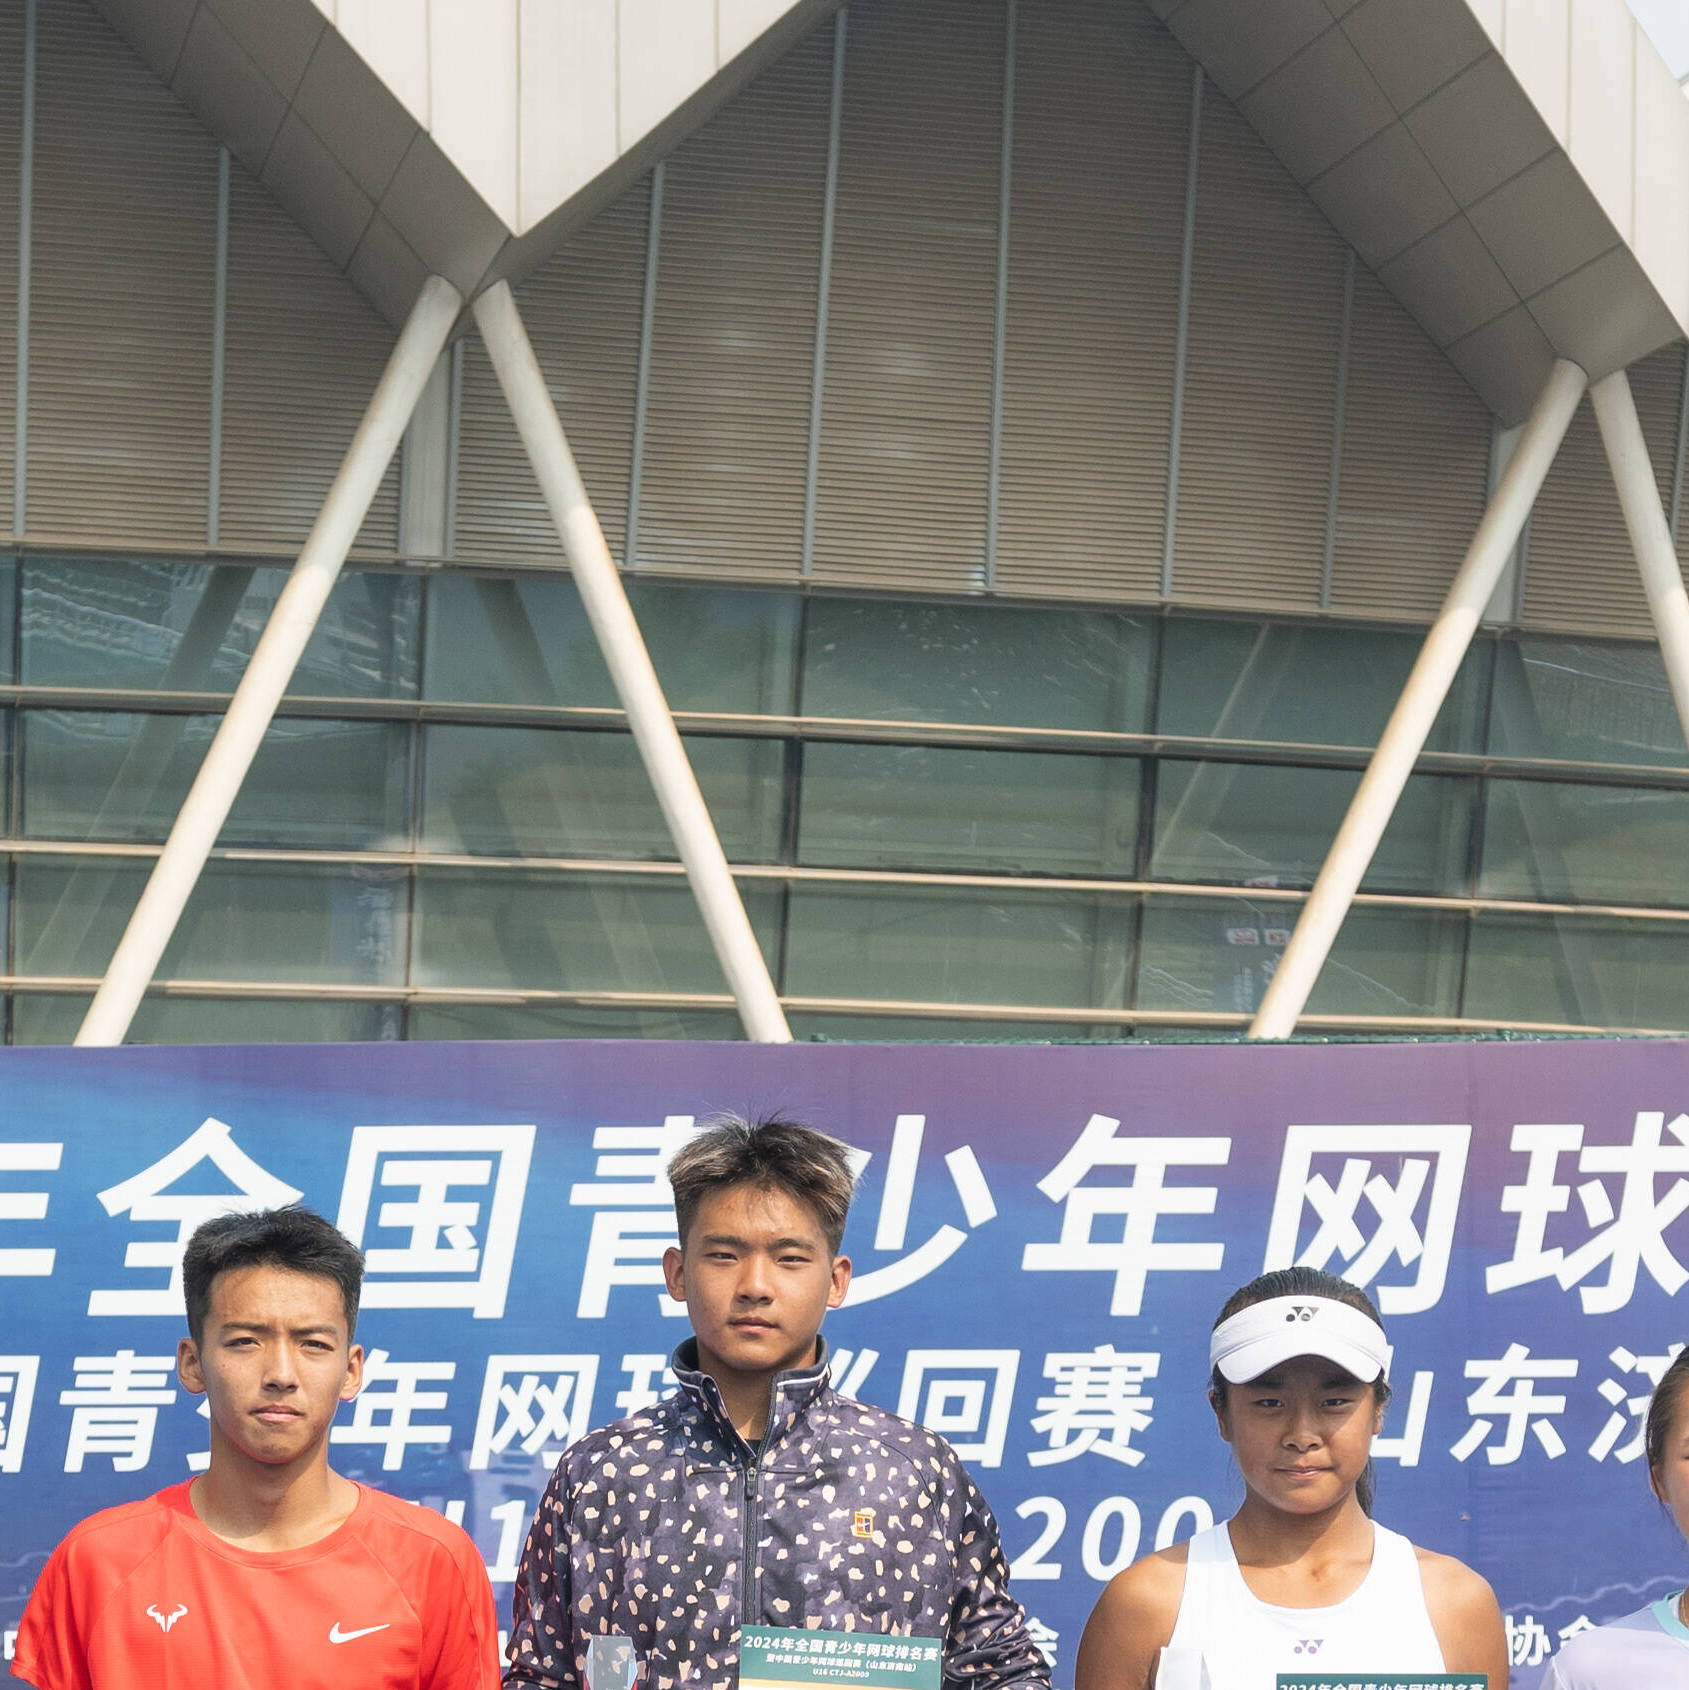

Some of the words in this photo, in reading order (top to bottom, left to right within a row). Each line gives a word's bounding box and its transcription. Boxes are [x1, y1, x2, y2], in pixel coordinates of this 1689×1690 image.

[744, 1635, 938, 1662] 2024年全国青少年网球排名赛
